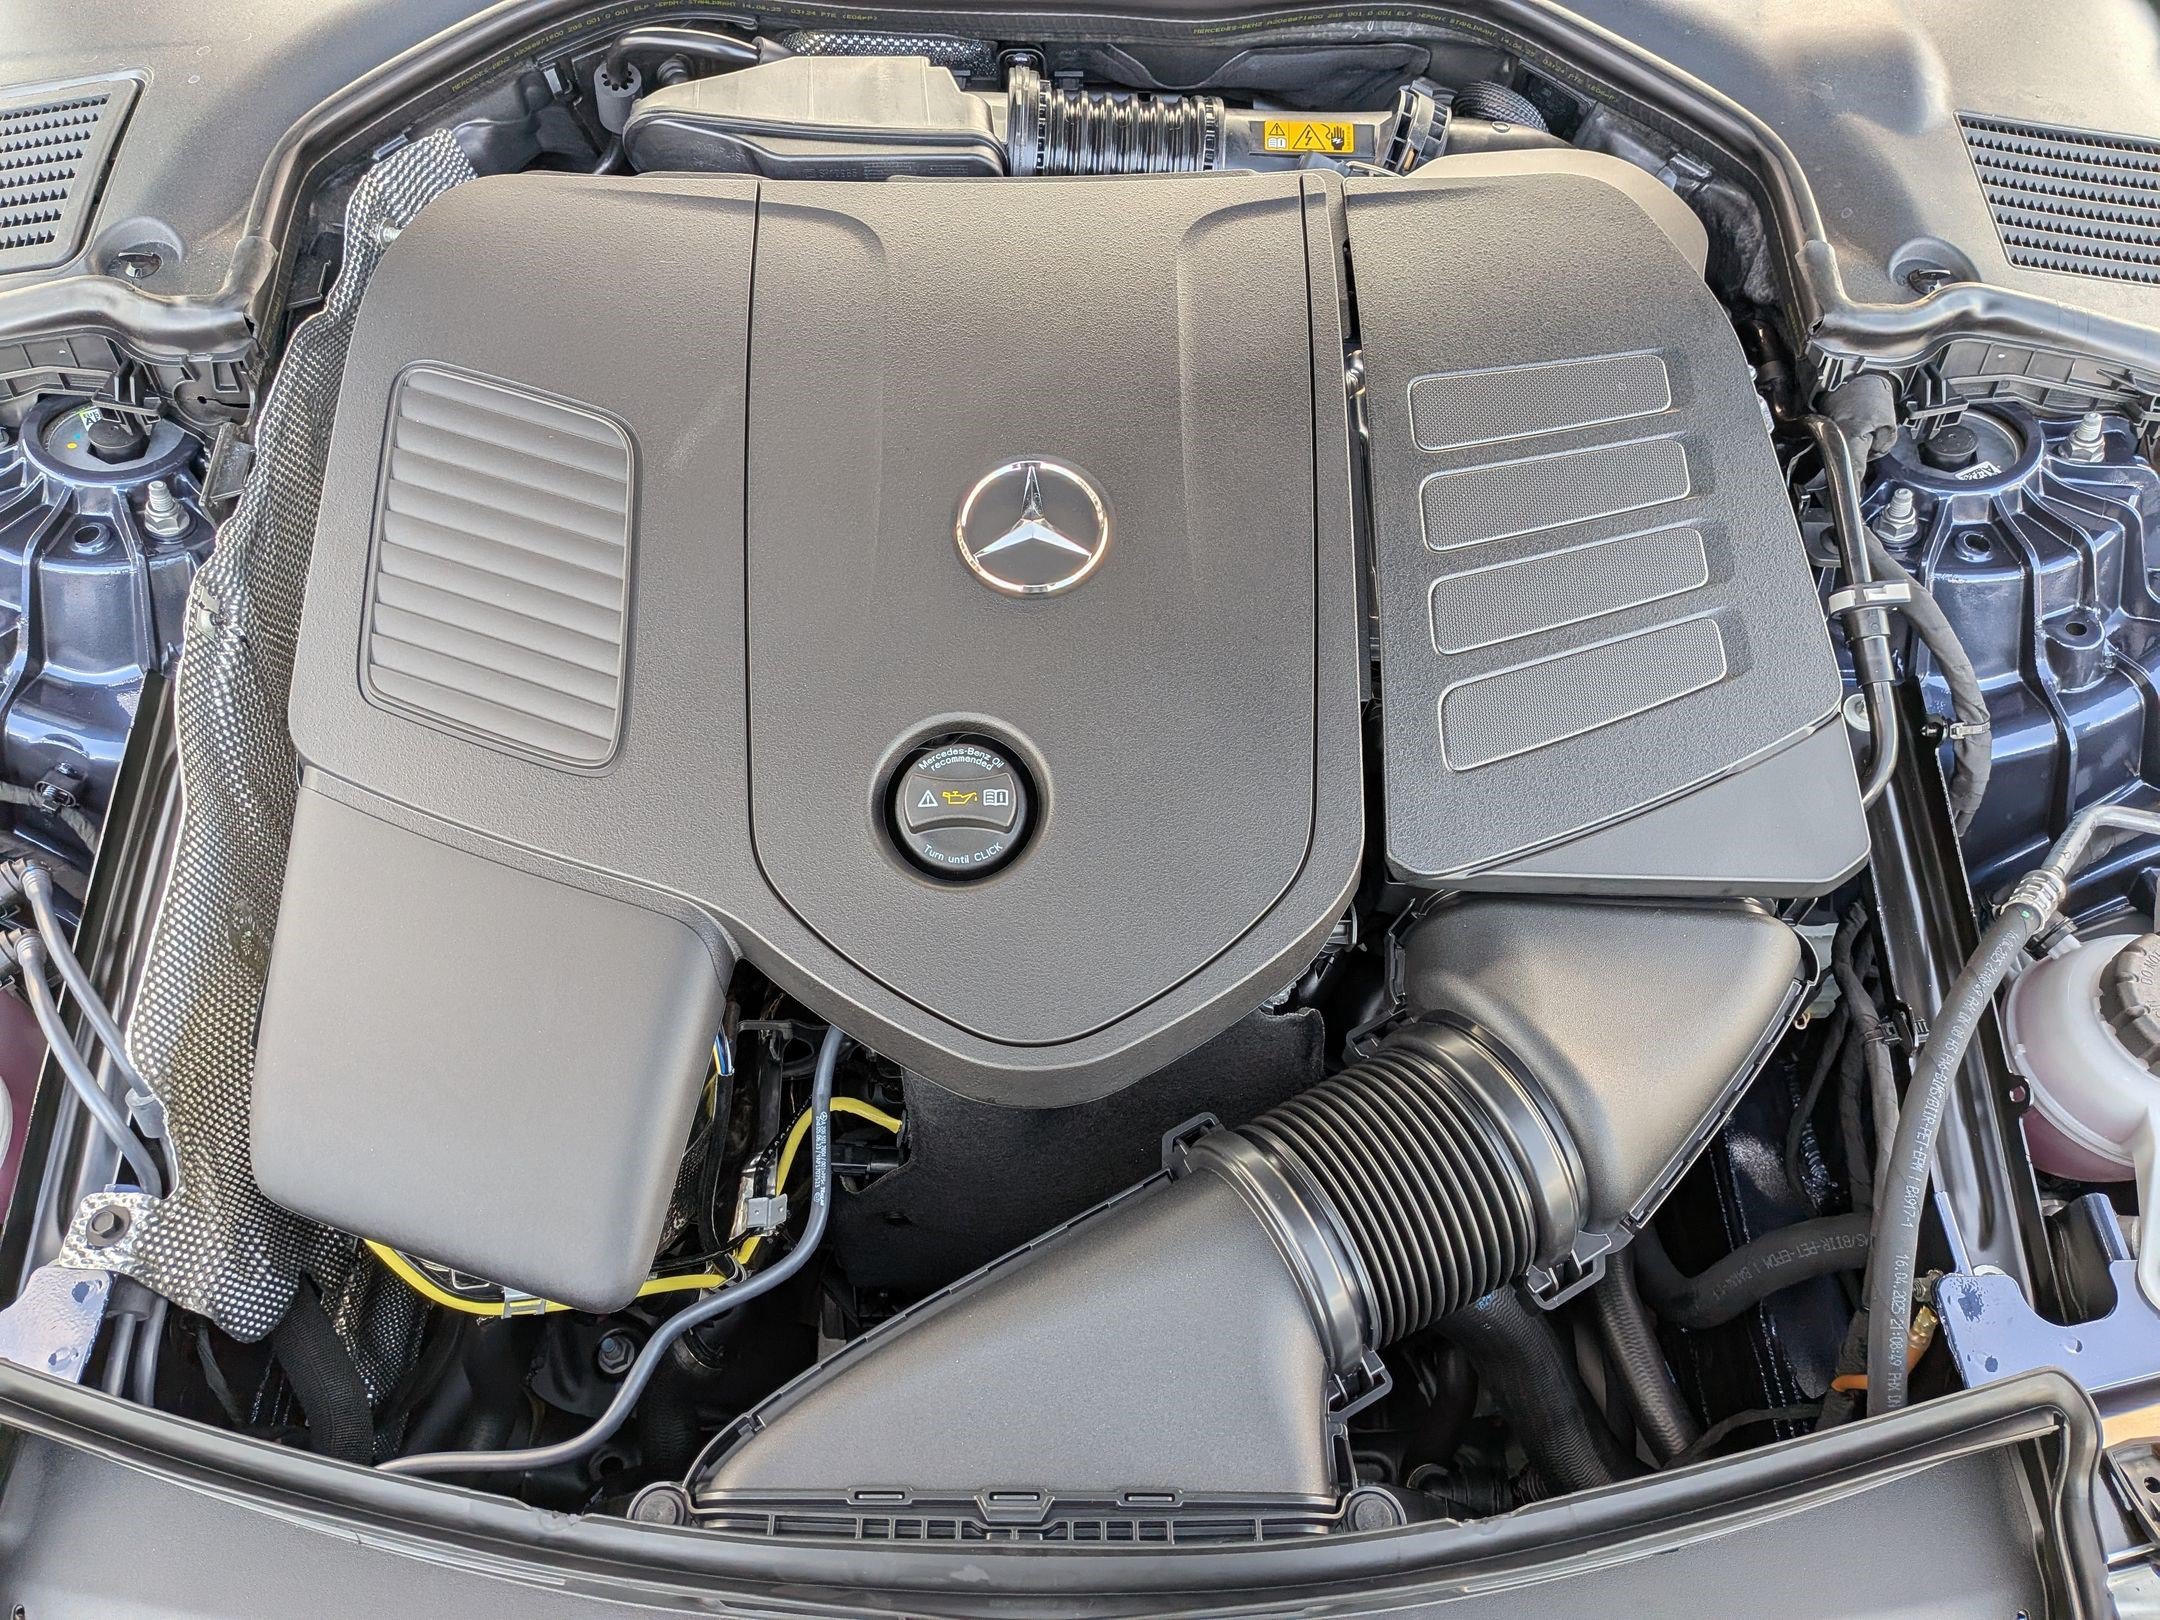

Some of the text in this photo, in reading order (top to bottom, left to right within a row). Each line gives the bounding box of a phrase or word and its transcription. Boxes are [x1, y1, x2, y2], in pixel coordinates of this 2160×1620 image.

[1193, 21, 1264, 34] MERCEDES-BENZ
[919, 747, 1005, 770] Mercedes-Benz Oil
[930, 756, 994, 771] recommended
[924, 842, 1003, 864] Turn until CLICK
[1891, 1253, 1910, 1316] 16.04.2025
